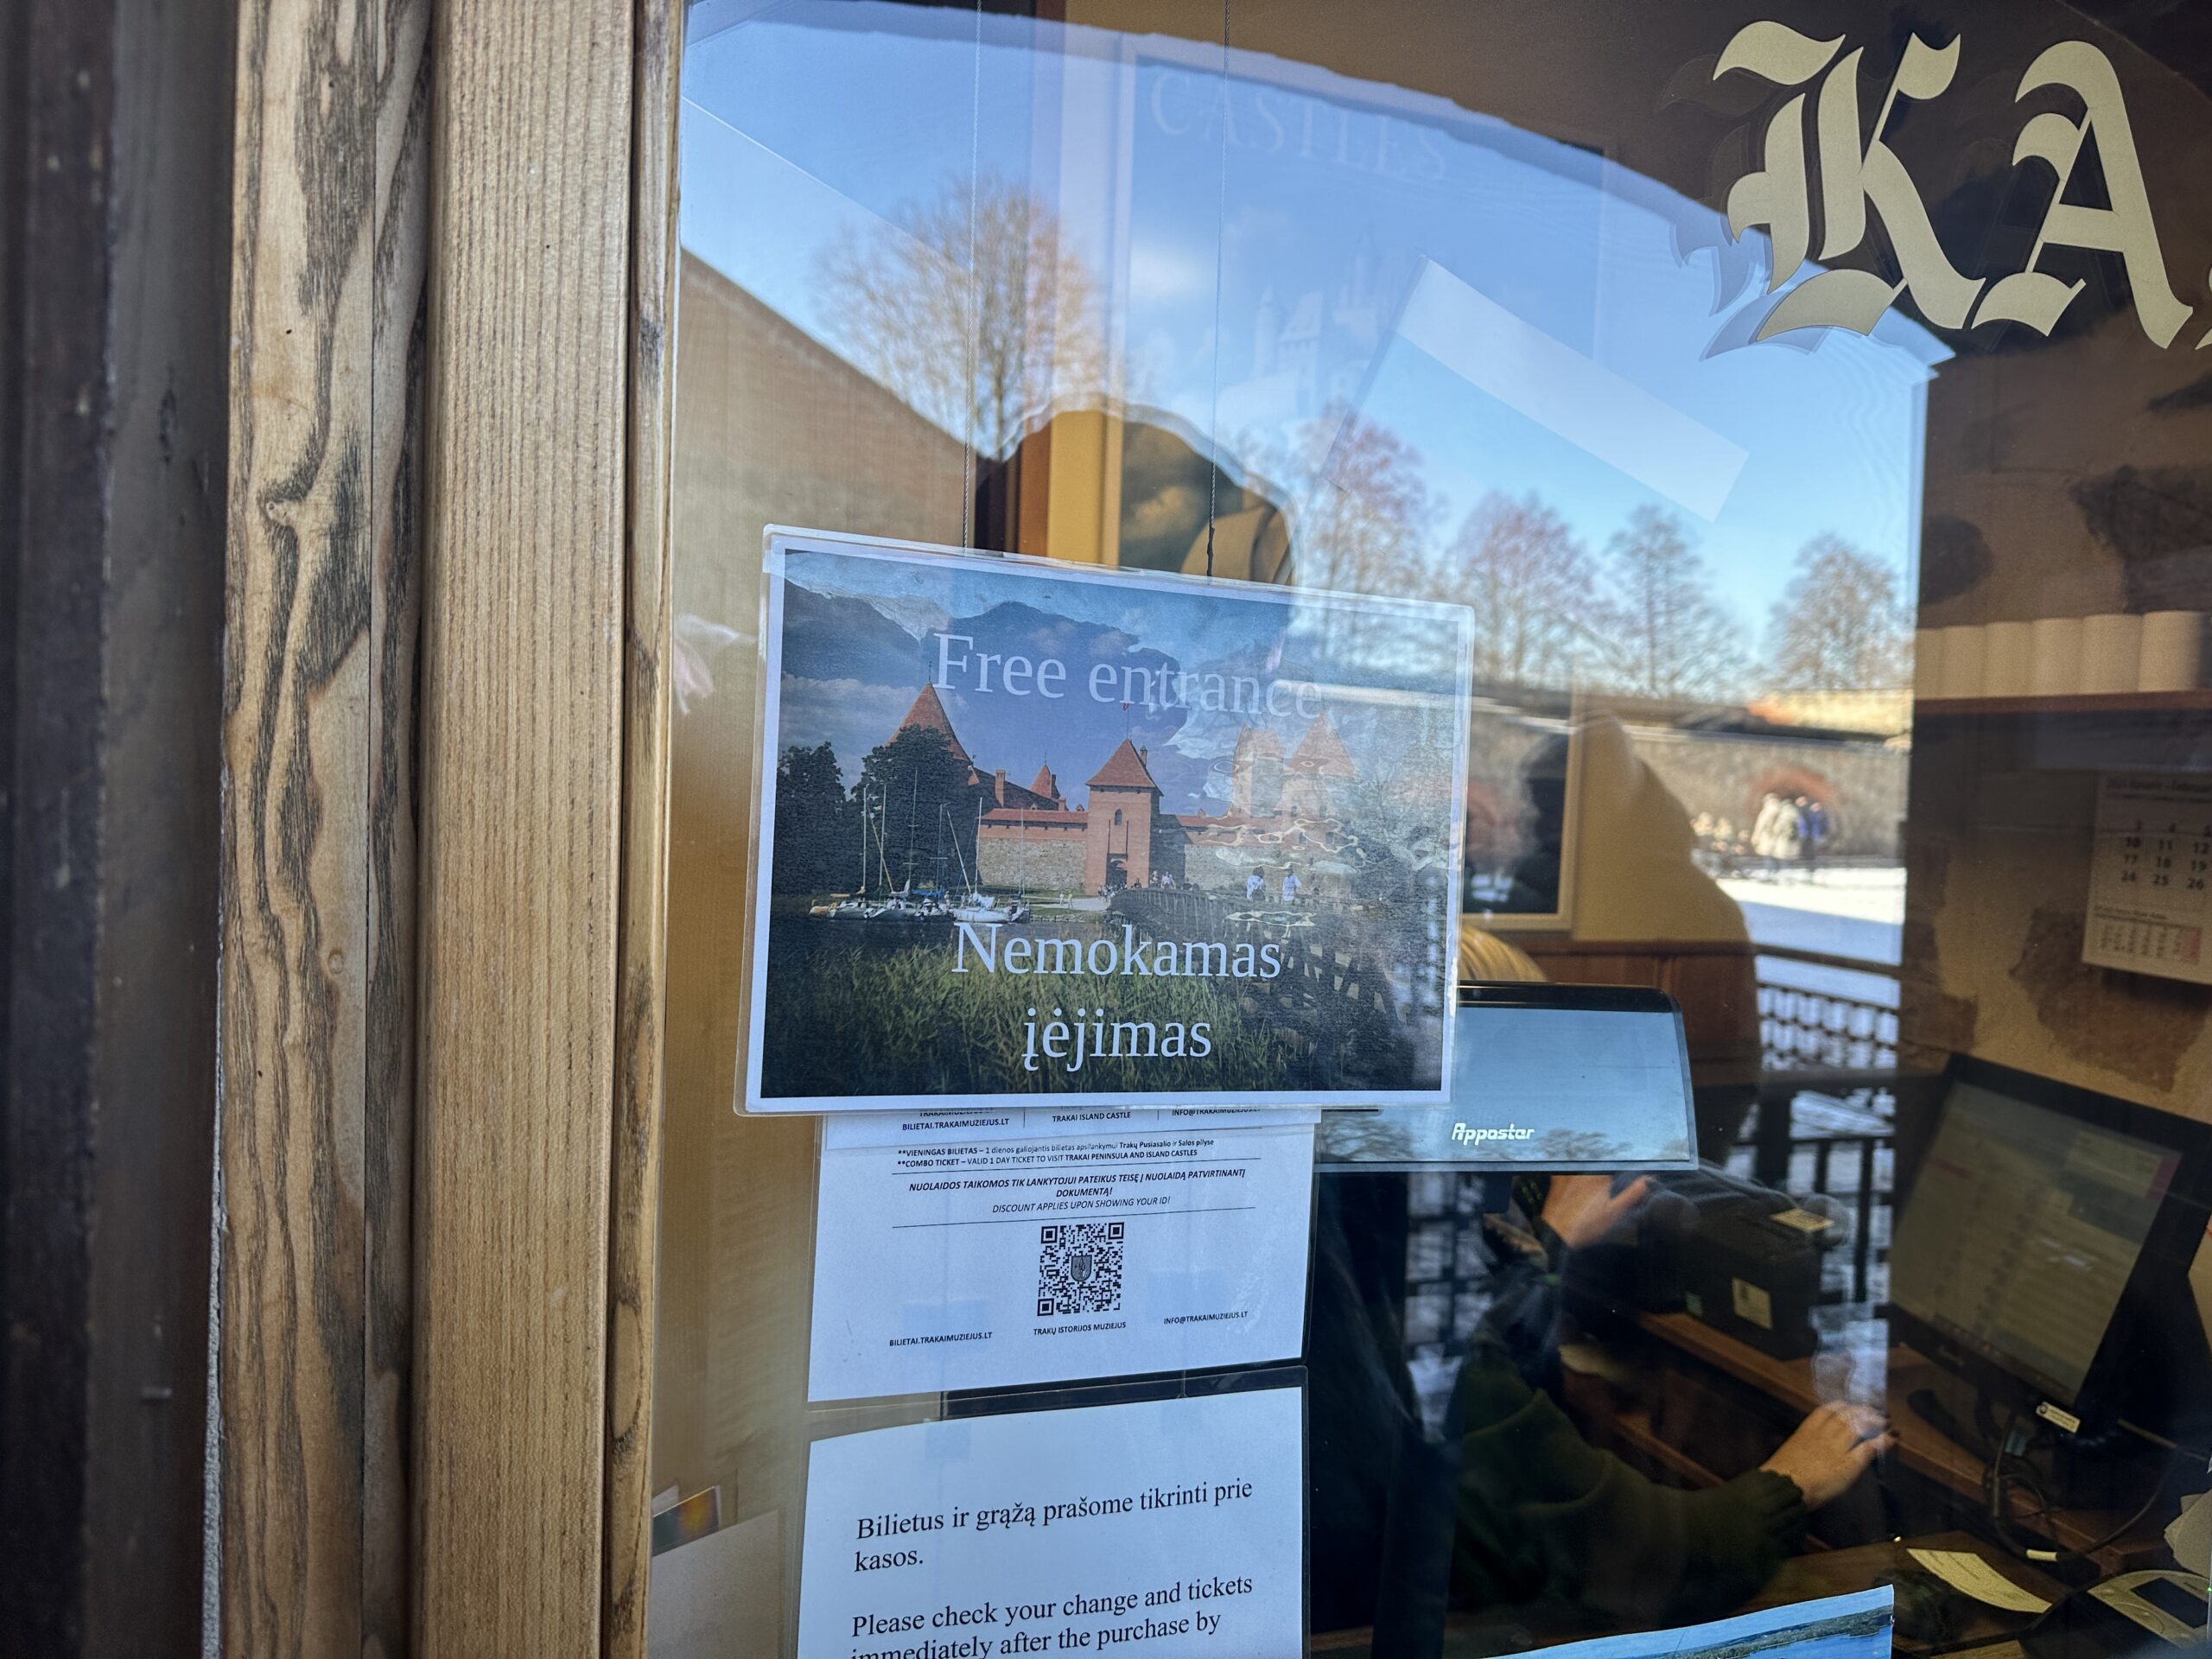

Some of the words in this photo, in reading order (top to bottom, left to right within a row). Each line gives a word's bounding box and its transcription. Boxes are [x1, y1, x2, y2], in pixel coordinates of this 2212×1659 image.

[1713, 20, 2212, 351] KA
[932, 632, 1066, 698] Free
[1088, 661, 1322, 718] entrance
[951, 922, 1281, 978] Nemokamas
[1021, 1007, 1211, 1071] įėjimas
[902, 1118, 1010, 1130] BILIETAI.TRAKAIMUZIEJUS.LT
[1052, 1114, 1077, 1122] TRAKAI
[1079, 1112, 1105, 1121] ISLAND
[1106, 1111, 1131, 1120] CASTLE
[947, 1147, 978, 1155] BILIETAS
[1015, 1145, 1050, 1154] galiojantis
[1077, 1142, 1118, 1151] apsilankymui
[1119, 1141, 1138, 1150] Trakų
[1196, 1138, 1214, 1147] pilyse
[1091, 1152, 1128, 1160] PENINSULA
[909, 1180, 961, 1192] NUOLAIDOS
[963, 1179, 1009, 1189] TAIKOMOS
[1012, 1178, 1025, 1186] TIK
[1026, 1176, 1077, 1186] LANKYTOJUI
[1078, 1174, 1116, 1184] PATEIKUS
[1118, 1173, 1139, 1184] TEISĘ
[1145, 1171, 1186, 1181] NUOLAIDĄ
[1187, 1168, 1246, 1179] PATVIRTINANTĮ
[1056, 1186, 1113, 1198] DOKUMENTĄ!
[992, 1202, 1035, 1213] DISCOUNT
[1036, 1200, 1068, 1211] APPLIES
[1070, 1199, 1094, 1209] UPON
[1095, 1198, 1135, 1207] SHOWING
[1135, 1197, 1157, 1205] YOUR
[1159, 1196, 1171, 1205] ID!
[1163, 1311, 1249, 1325] INFO@TRAKAIMUZIEJUS.LT
[1033, 1327, 1056, 1336] TRAKŲ
[1058, 1325, 1092, 1333] ISTORIJOS
[1093, 1322, 1127, 1332] MUZIEJUS
[889, 1332, 993, 1347] BILIETAI.TRAKAIMUZIEJUS.LT
[856, 1514, 944, 1540] Bilietus
[952, 1506, 969, 1528] ir
[976, 1502, 1036, 1531] grąžą
[1042, 1496, 1134, 1526] prašome
[1140, 1481, 1208, 1510] tikrinti
[1214, 1478, 1253, 1507] prie
[854, 1549, 924, 1573] kasos.
[851, 1613, 925, 1637] Please
[931, 1602, 999, 1628] check
[1005, 1602, 1057, 1627] your
[1063, 1593, 1139, 1616] change
[1145, 1581, 1181, 1606] and
[1188, 1575, 1253, 1600] tickets
[1000, 1630, 1052, 1655] after
[1058, 1627, 1091, 1650] the
[1096, 1618, 1190, 1650] purchase
[1196, 1611, 1222, 1635] by
